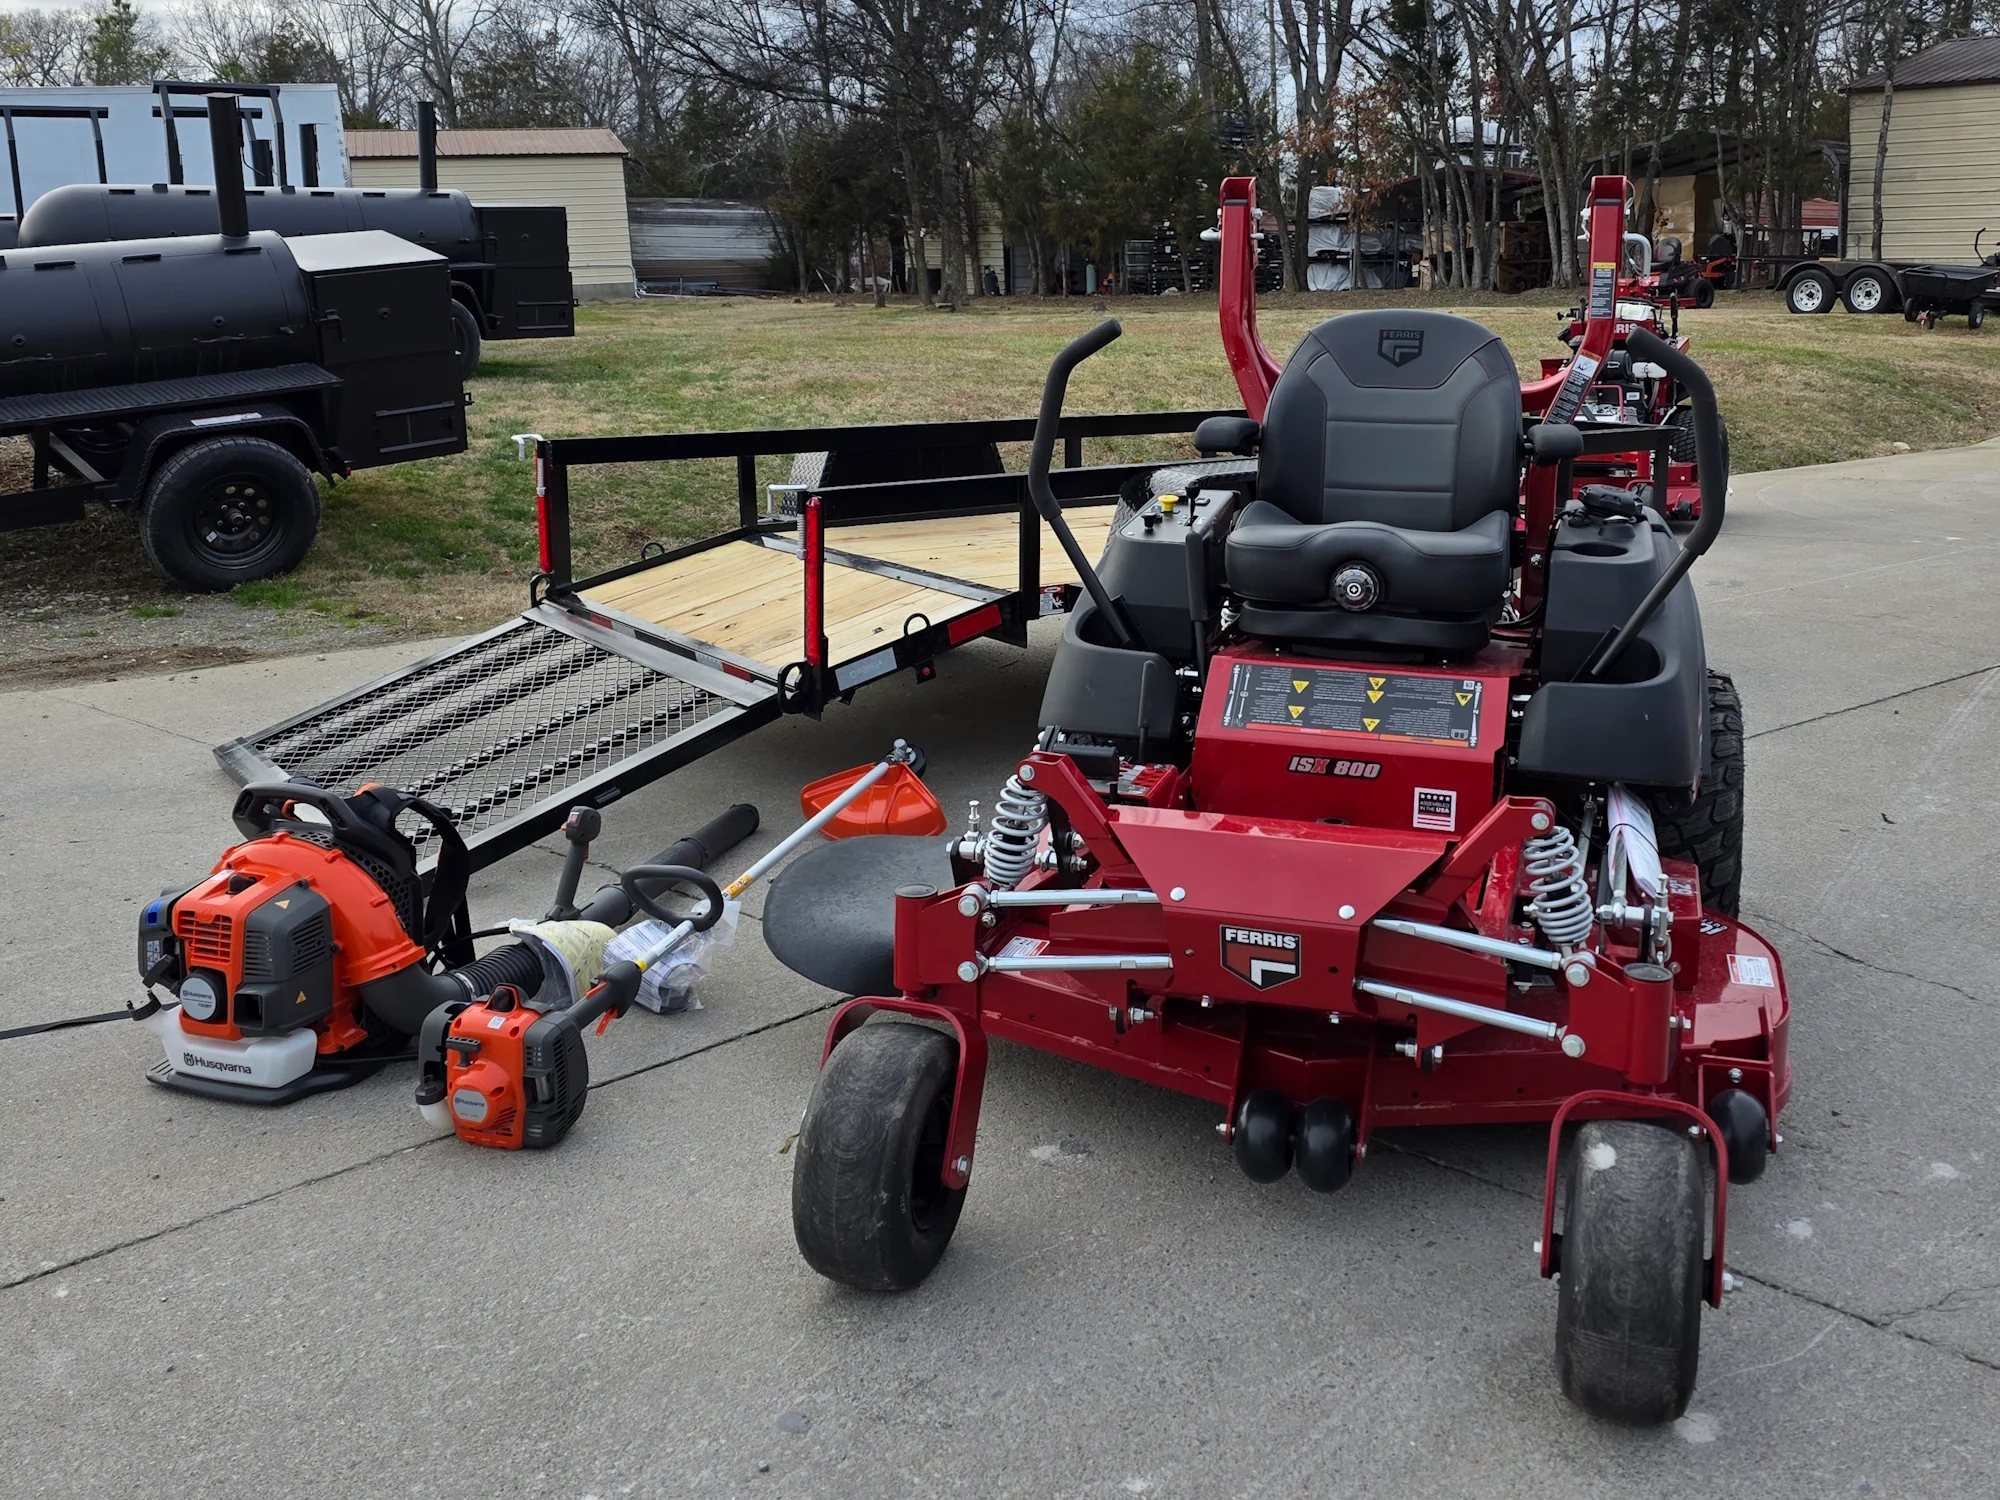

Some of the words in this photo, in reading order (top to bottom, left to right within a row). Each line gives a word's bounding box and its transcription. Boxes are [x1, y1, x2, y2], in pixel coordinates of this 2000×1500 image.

[1383, 331, 1421, 339] FERRIS
[1289, 756, 1330, 774] ISX
[1333, 760, 1380, 778] 800
[1225, 928, 1297, 949] FERRIS
[194, 1056, 252, 1074] Husqvarna
